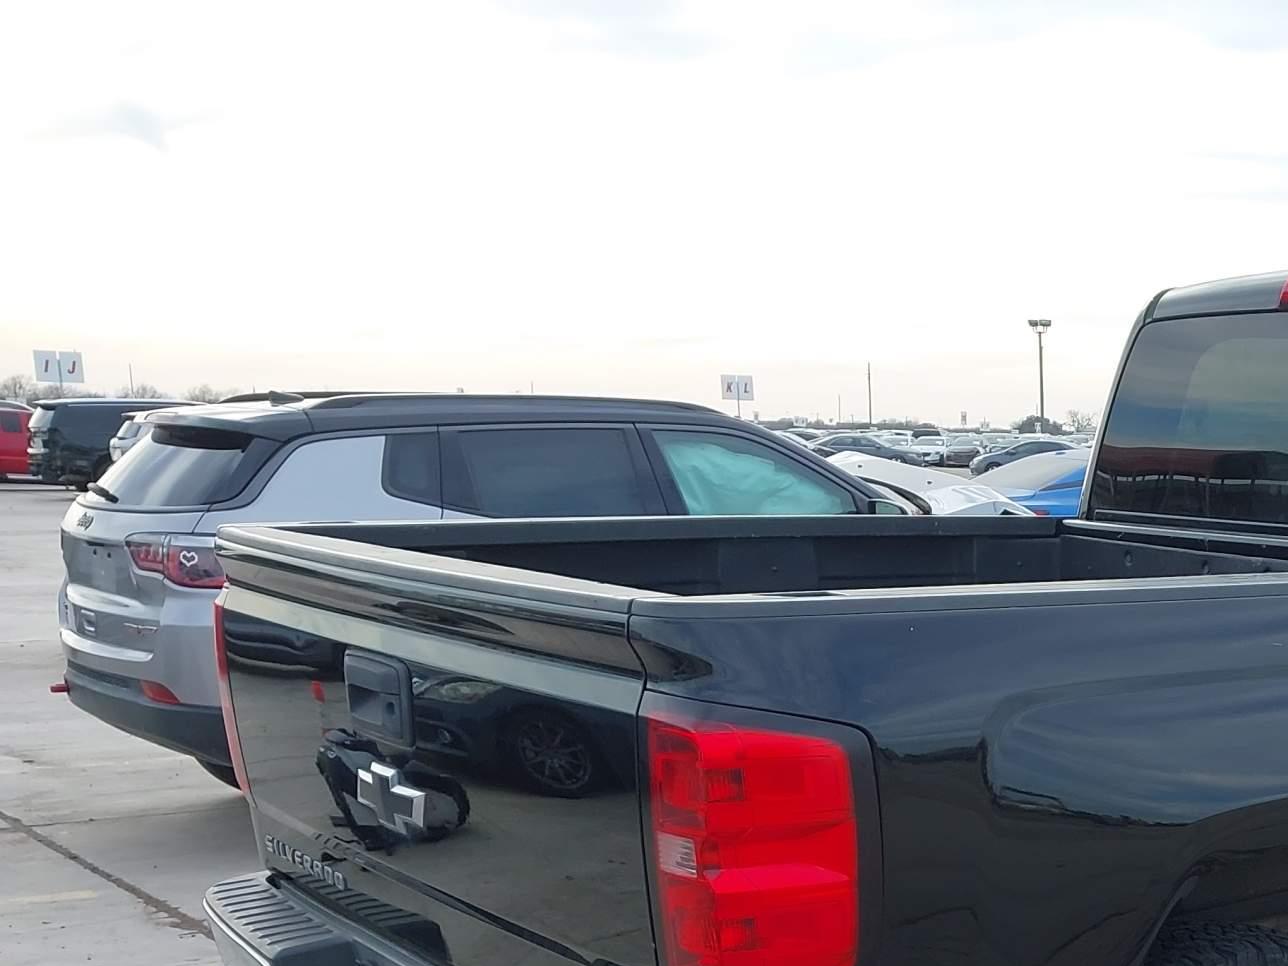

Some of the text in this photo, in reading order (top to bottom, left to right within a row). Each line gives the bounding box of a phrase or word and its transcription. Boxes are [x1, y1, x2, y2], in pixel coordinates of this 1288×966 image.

[67, 360, 76, 374] J
[726, 381, 733, 393] K
[743, 382, 750, 394] L
[264, 834, 345, 891] SILVERADO
